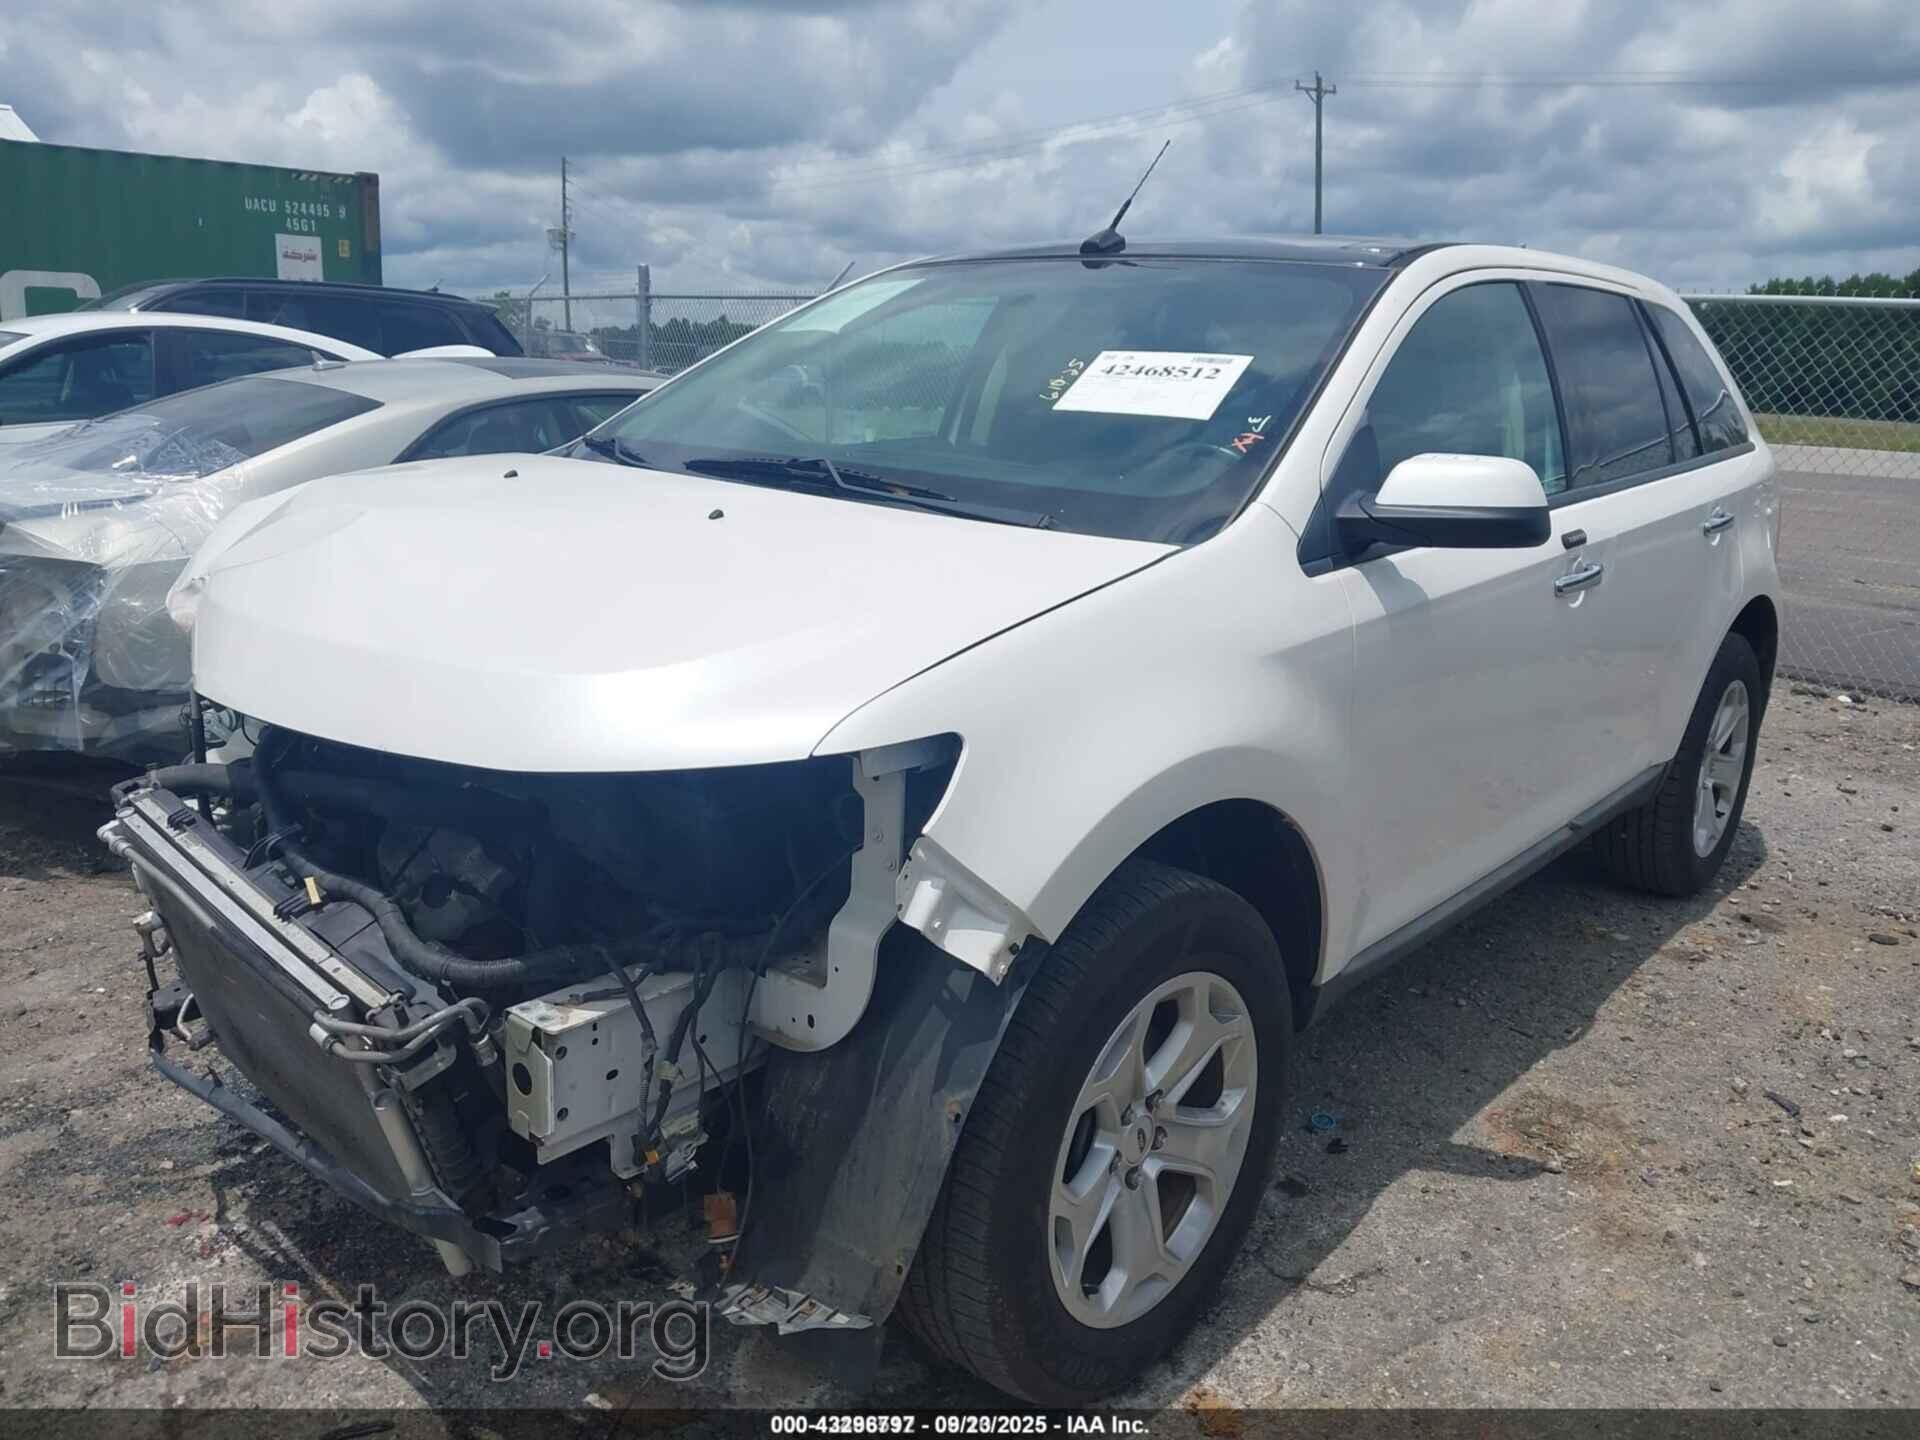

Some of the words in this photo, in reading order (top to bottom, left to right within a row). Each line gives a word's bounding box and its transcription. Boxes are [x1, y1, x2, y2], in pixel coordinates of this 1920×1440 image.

[244, 196, 277, 213] UACU
[286, 217, 316, 233] 45G1
[1100, 364, 1222, 381] 42468512
